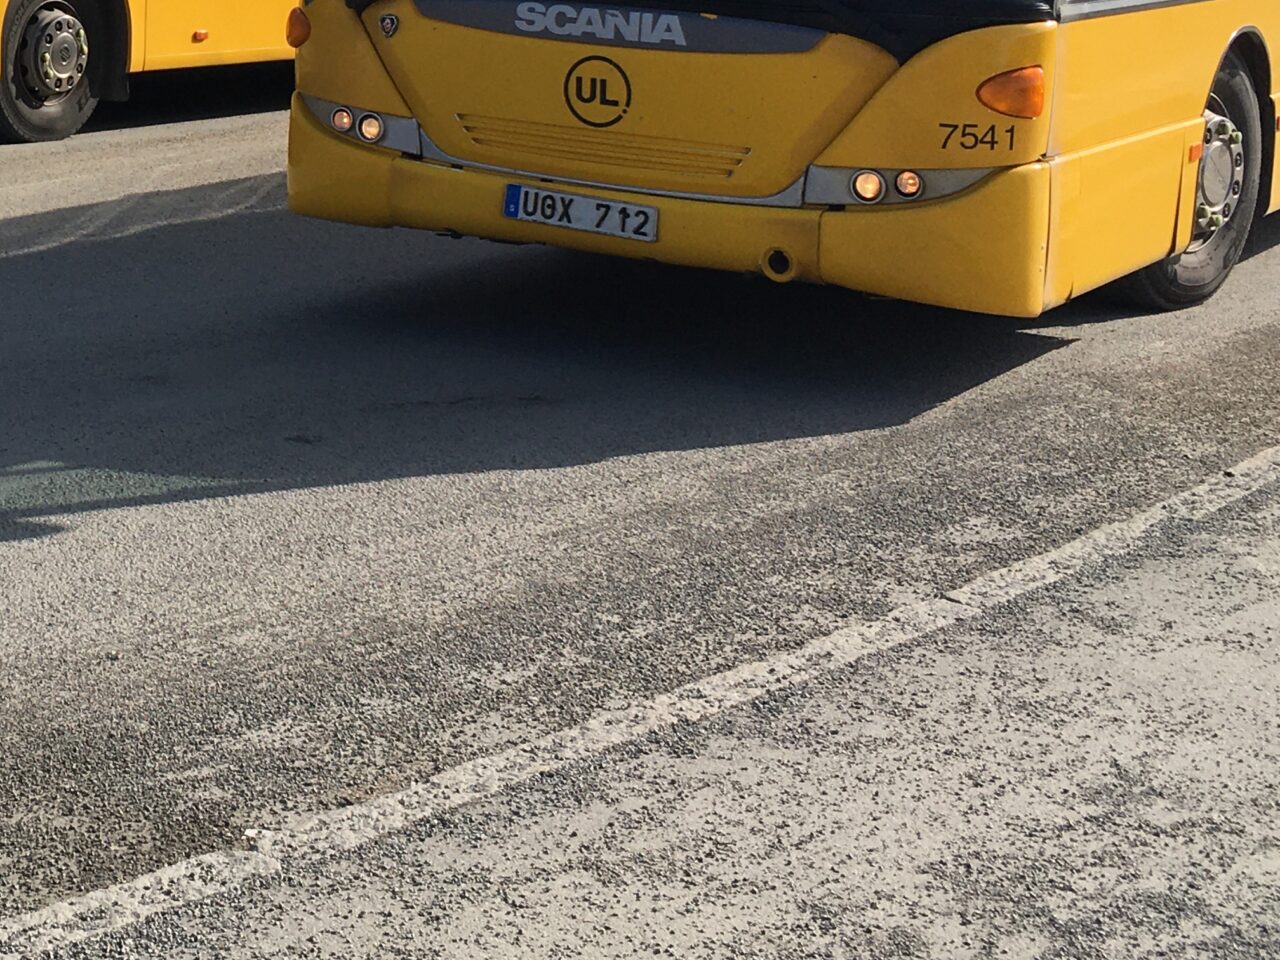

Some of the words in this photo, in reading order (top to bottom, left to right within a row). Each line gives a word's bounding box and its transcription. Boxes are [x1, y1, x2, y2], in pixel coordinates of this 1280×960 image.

[515, 1, 687, 46] SCANIA
[575, 75, 621, 108] UL
[937, 122, 1017, 152] 7541
[595, 202, 650, 237] 712
